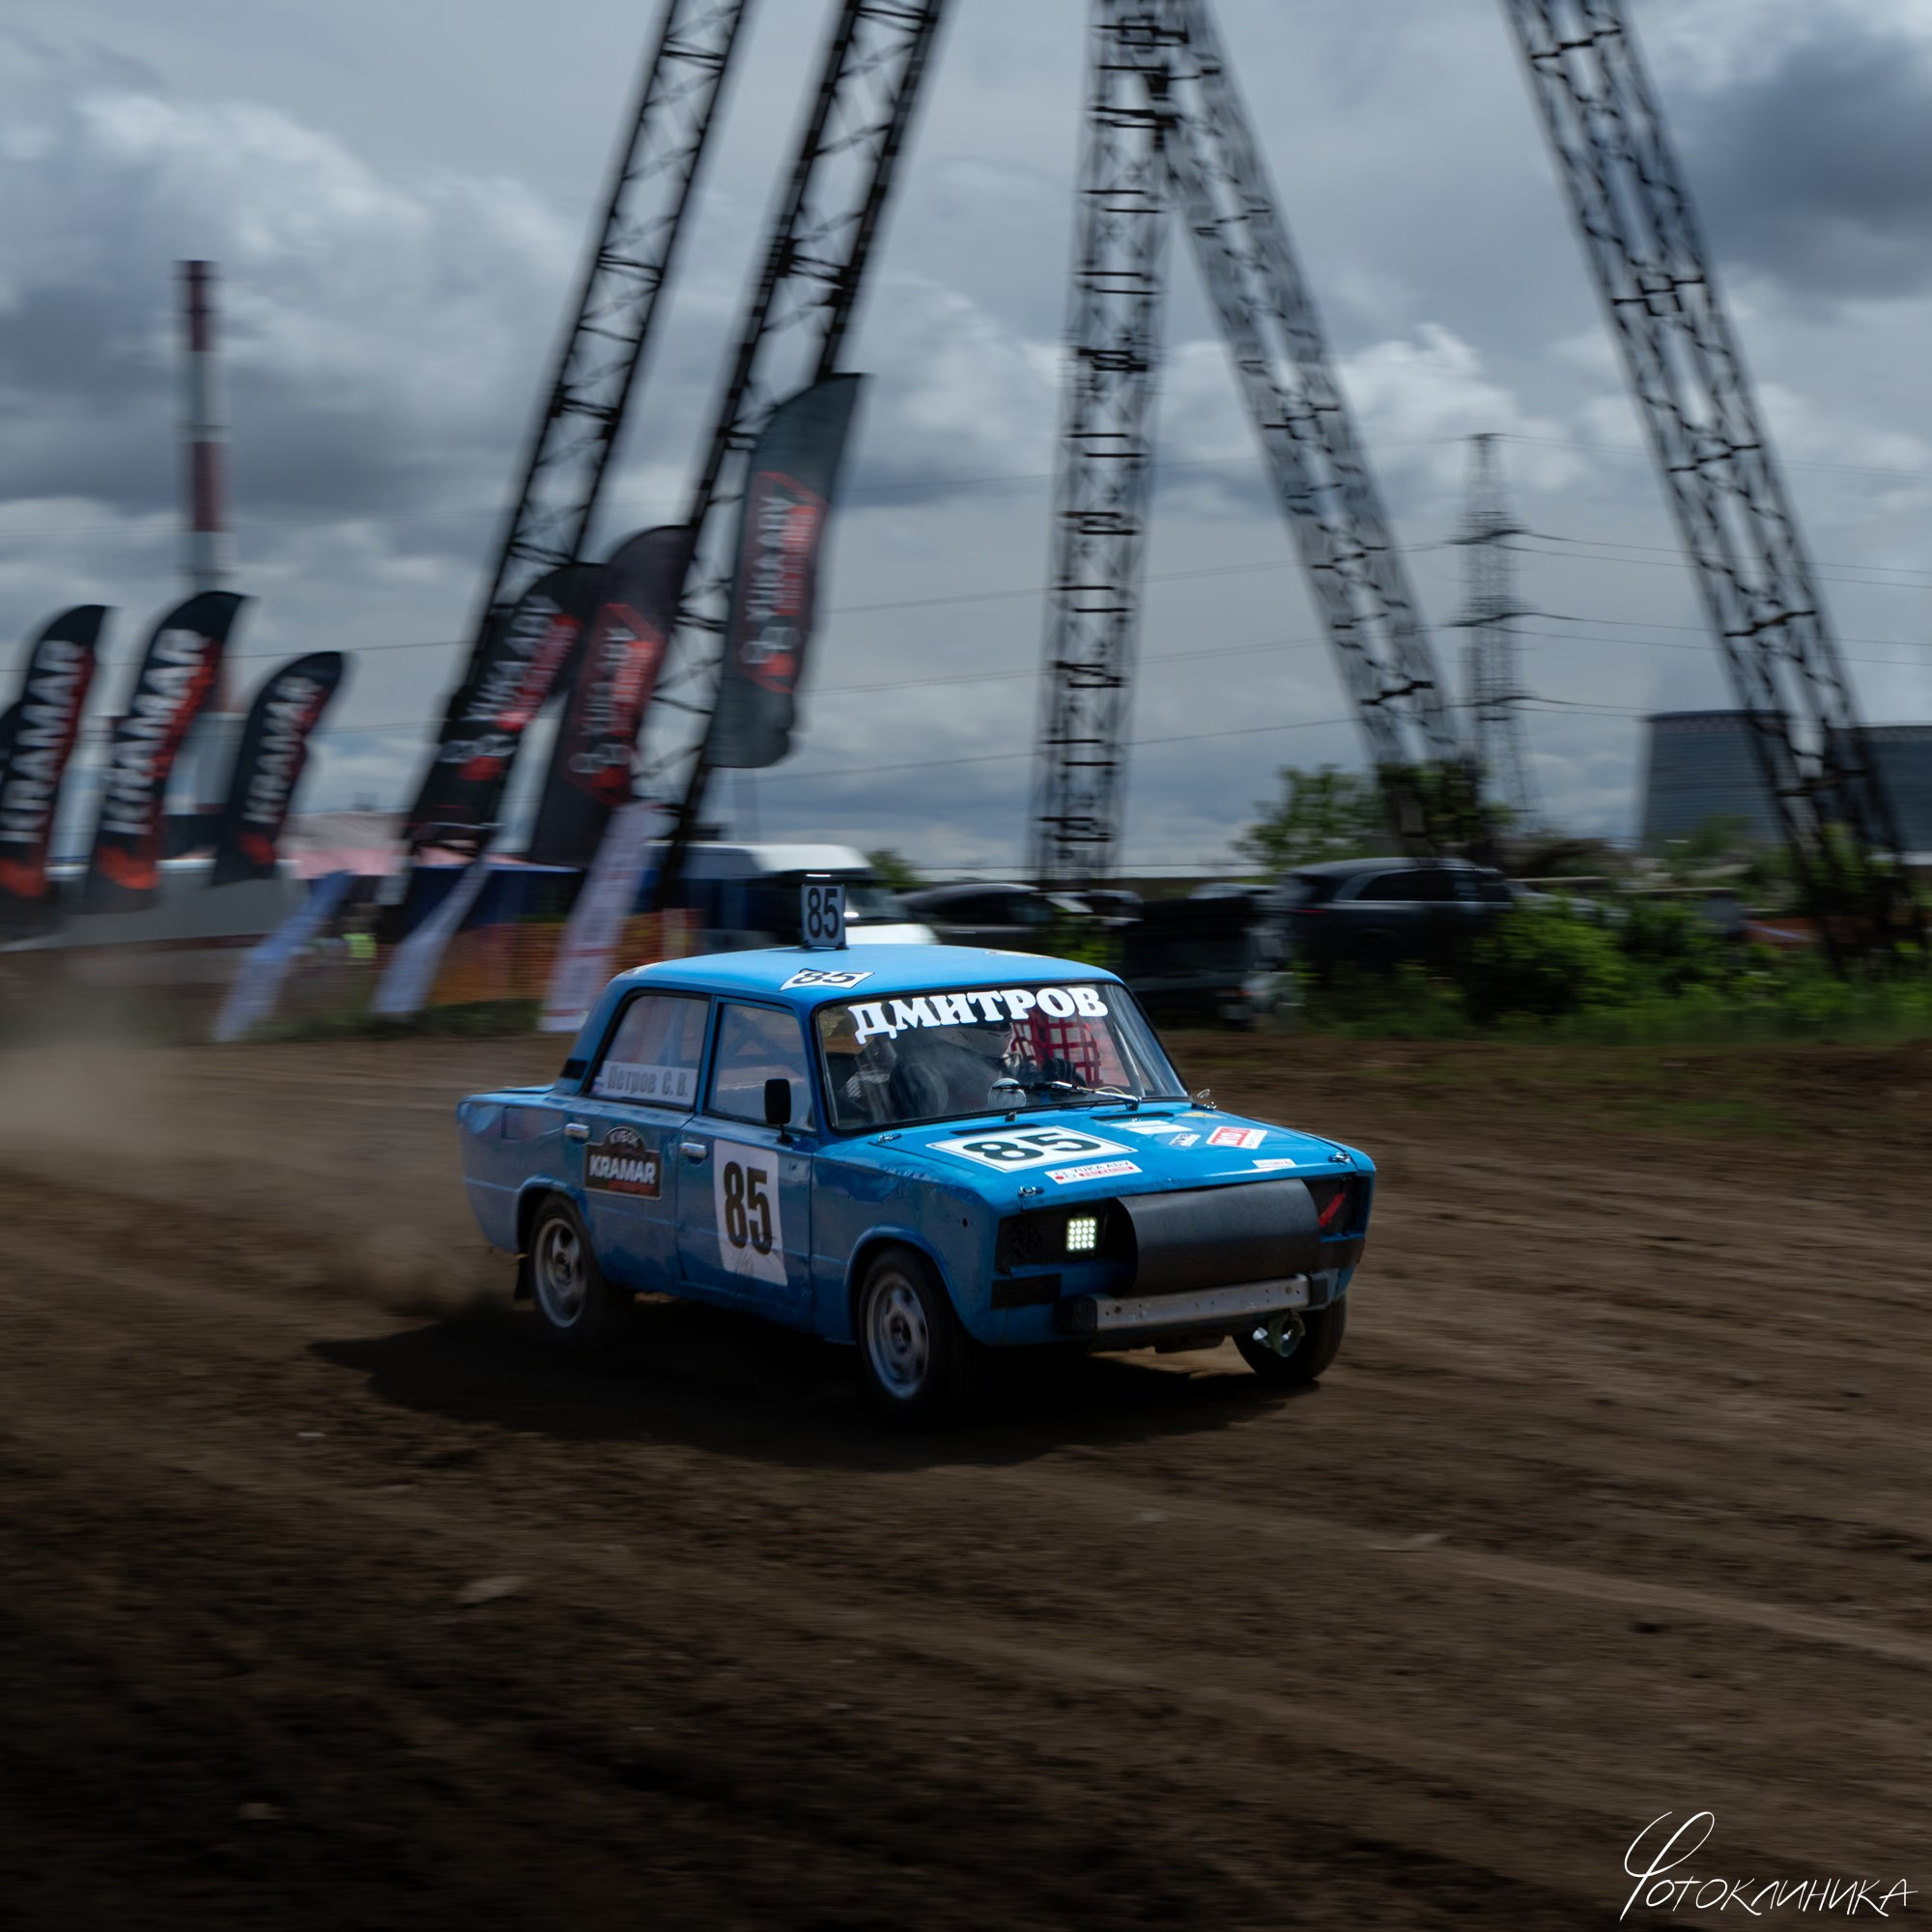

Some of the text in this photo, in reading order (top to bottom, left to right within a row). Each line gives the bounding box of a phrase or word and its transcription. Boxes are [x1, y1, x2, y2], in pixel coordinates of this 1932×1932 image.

[808, 887, 839, 939] 85
[792, 972, 865, 984] 85
[848, 987, 1108, 1044] ДМИТРОВ
[607, 1065, 657, 1094] Петров
[962, 1132, 1102, 1160] 85
[588, 1153, 656, 1184] KRAMAR
[724, 1161, 773, 1255] 85
